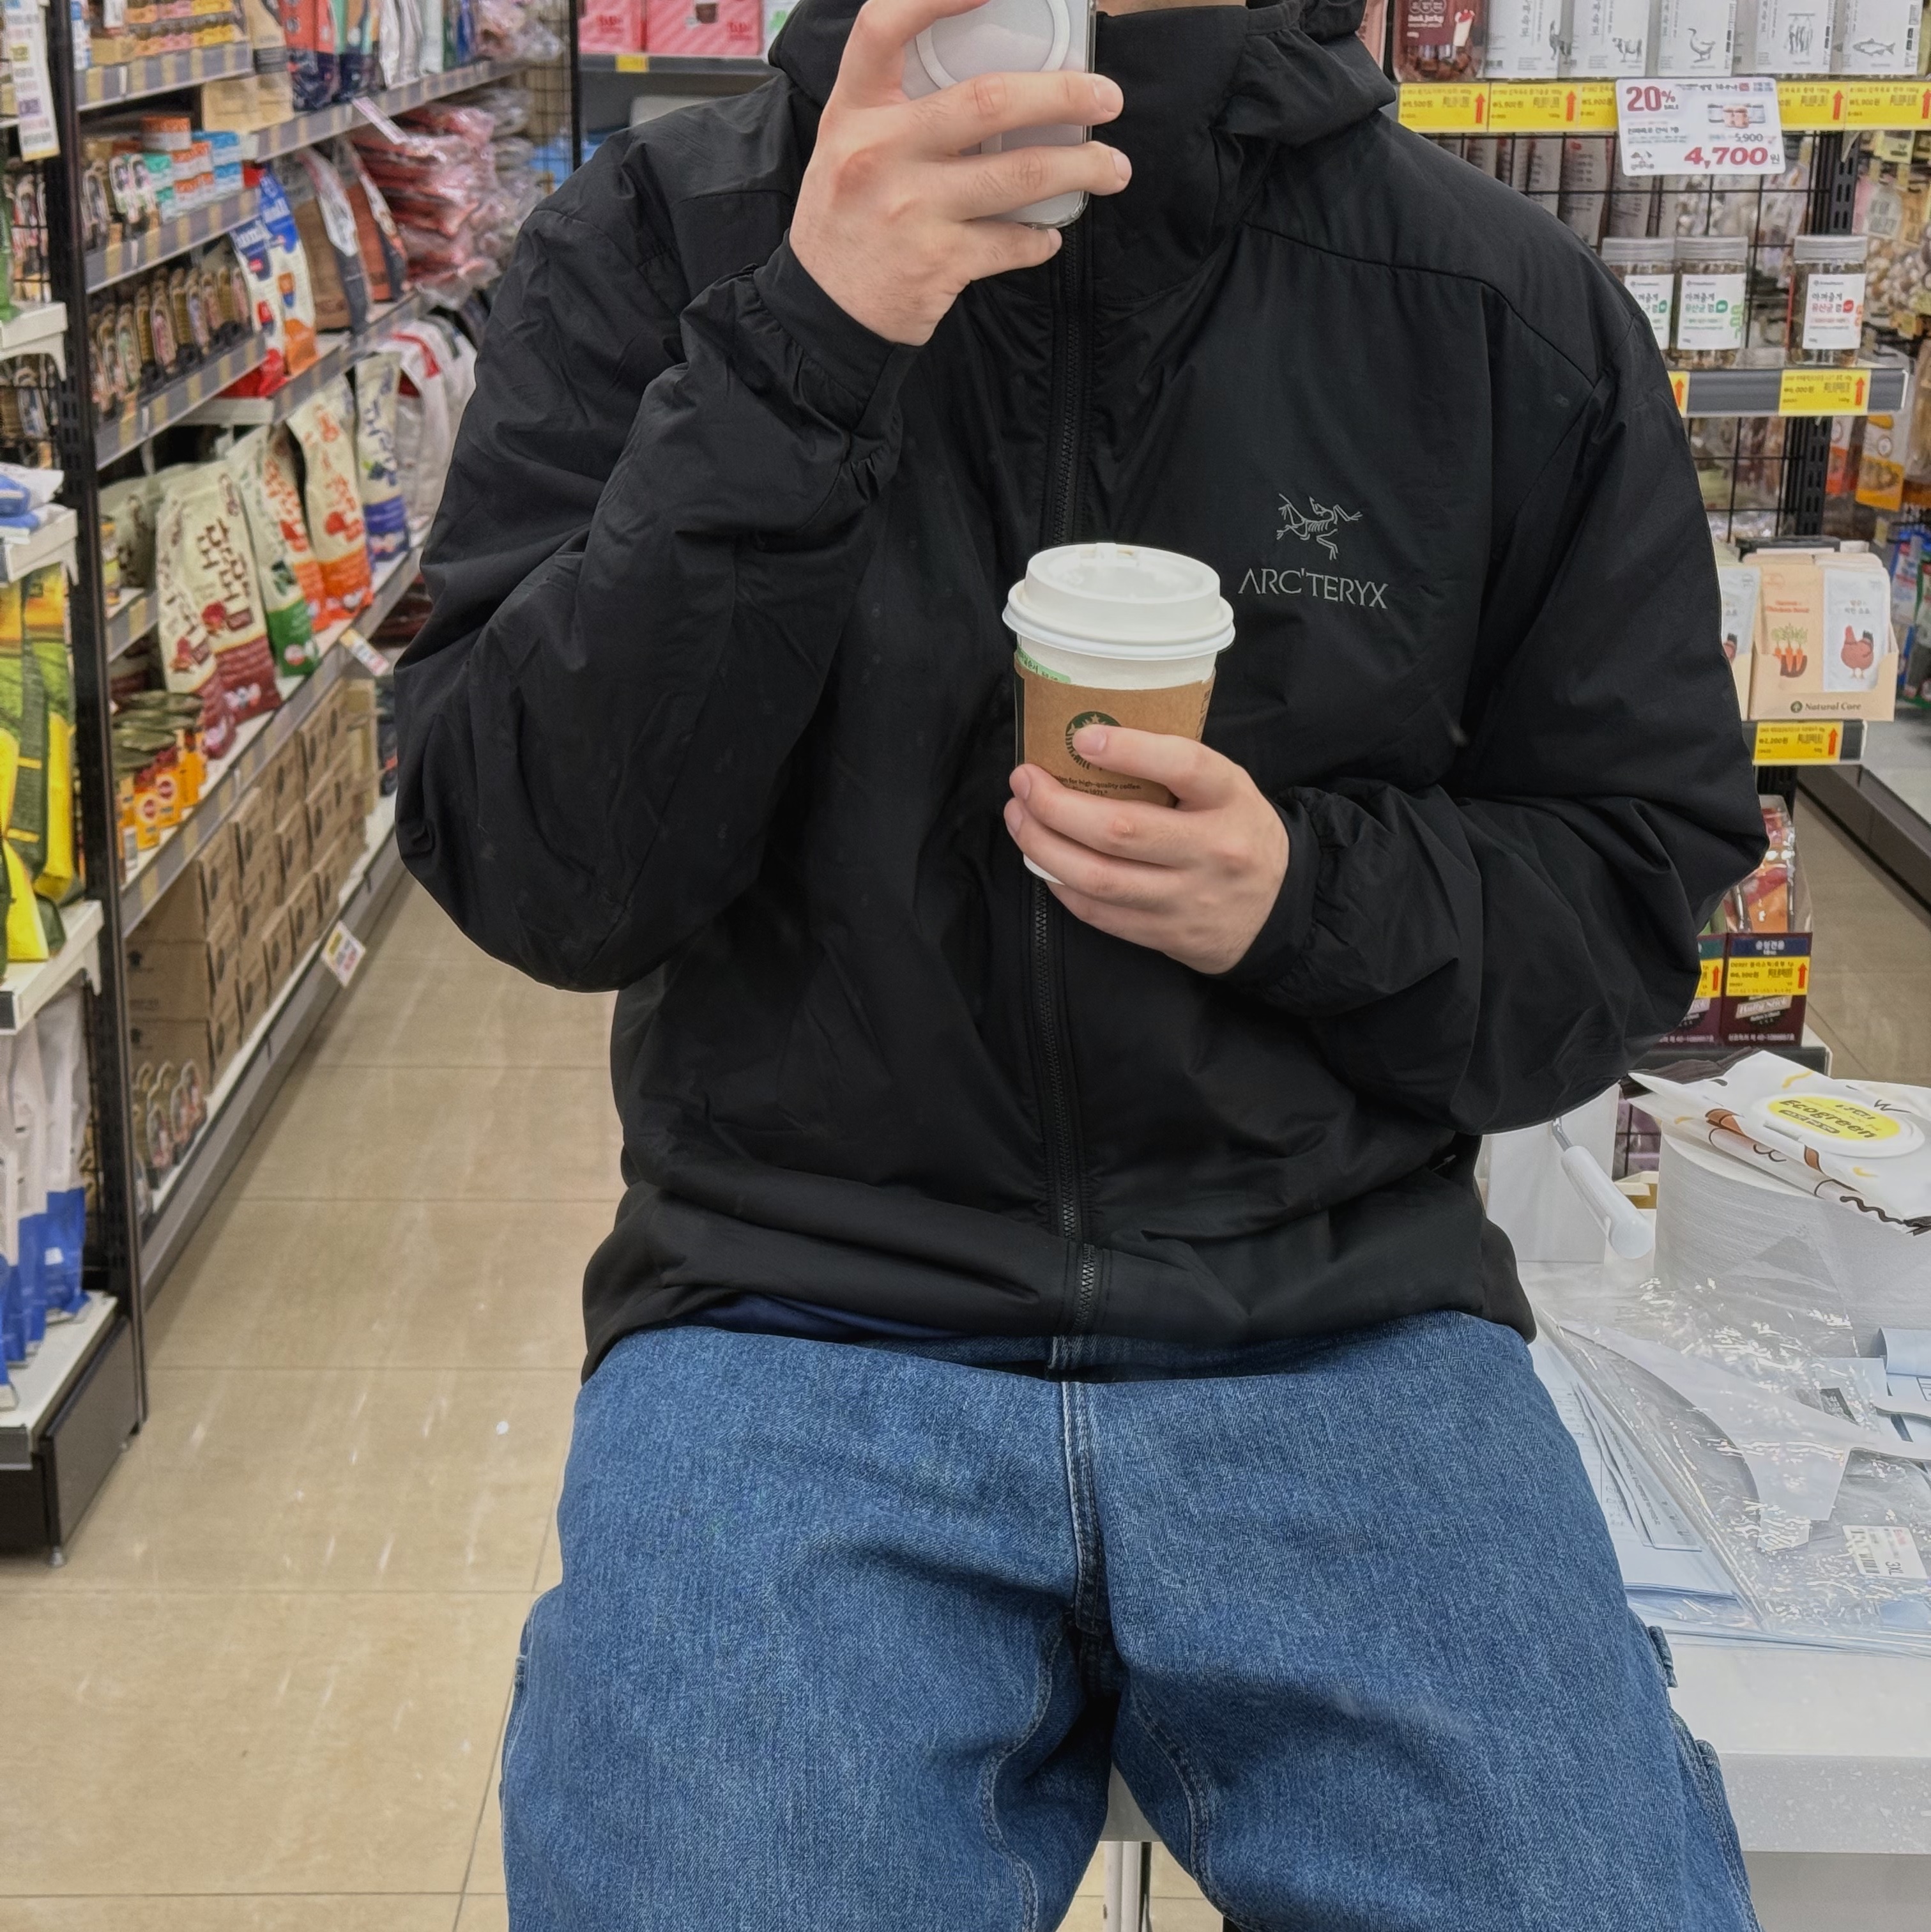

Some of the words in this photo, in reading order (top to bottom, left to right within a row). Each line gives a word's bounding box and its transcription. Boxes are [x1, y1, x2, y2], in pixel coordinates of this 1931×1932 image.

[1238, 568, 1389, 610] ARC'TERYX
[1805, 702, 1839, 710] Natural
[1079, 779, 1118, 790] high-quality
[1778, 1100, 1877, 1138] Ecogreen
[1885, 1561, 1904, 1576] 3XL
